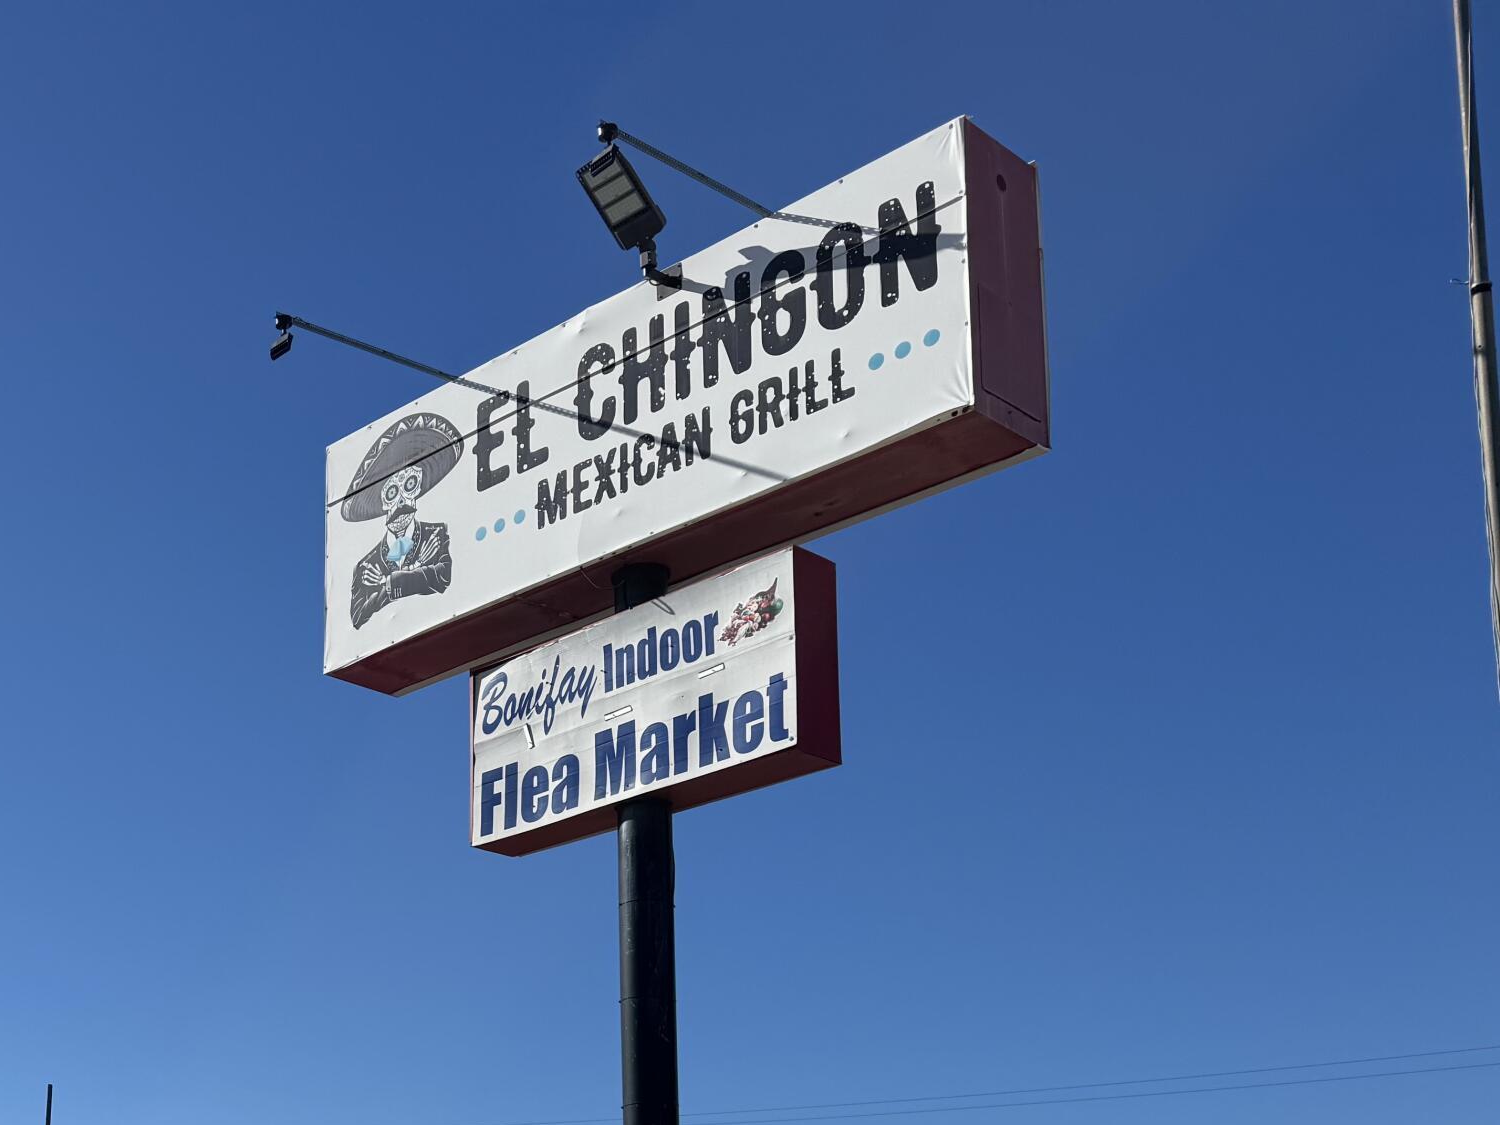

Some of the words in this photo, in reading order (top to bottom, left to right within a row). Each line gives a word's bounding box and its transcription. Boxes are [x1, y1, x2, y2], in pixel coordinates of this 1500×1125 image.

[472, 380, 549, 492] EL
[574, 181, 941, 441] CHINGON
[534, 406, 713, 530] MEXICAN
[728, 348, 856, 445] GRILL
[480, 753, 580, 837] Flea
[593, 672, 788, 801] Market
[481, 655, 597, 735] Bonifay
[603, 610, 719, 693] Indoor
